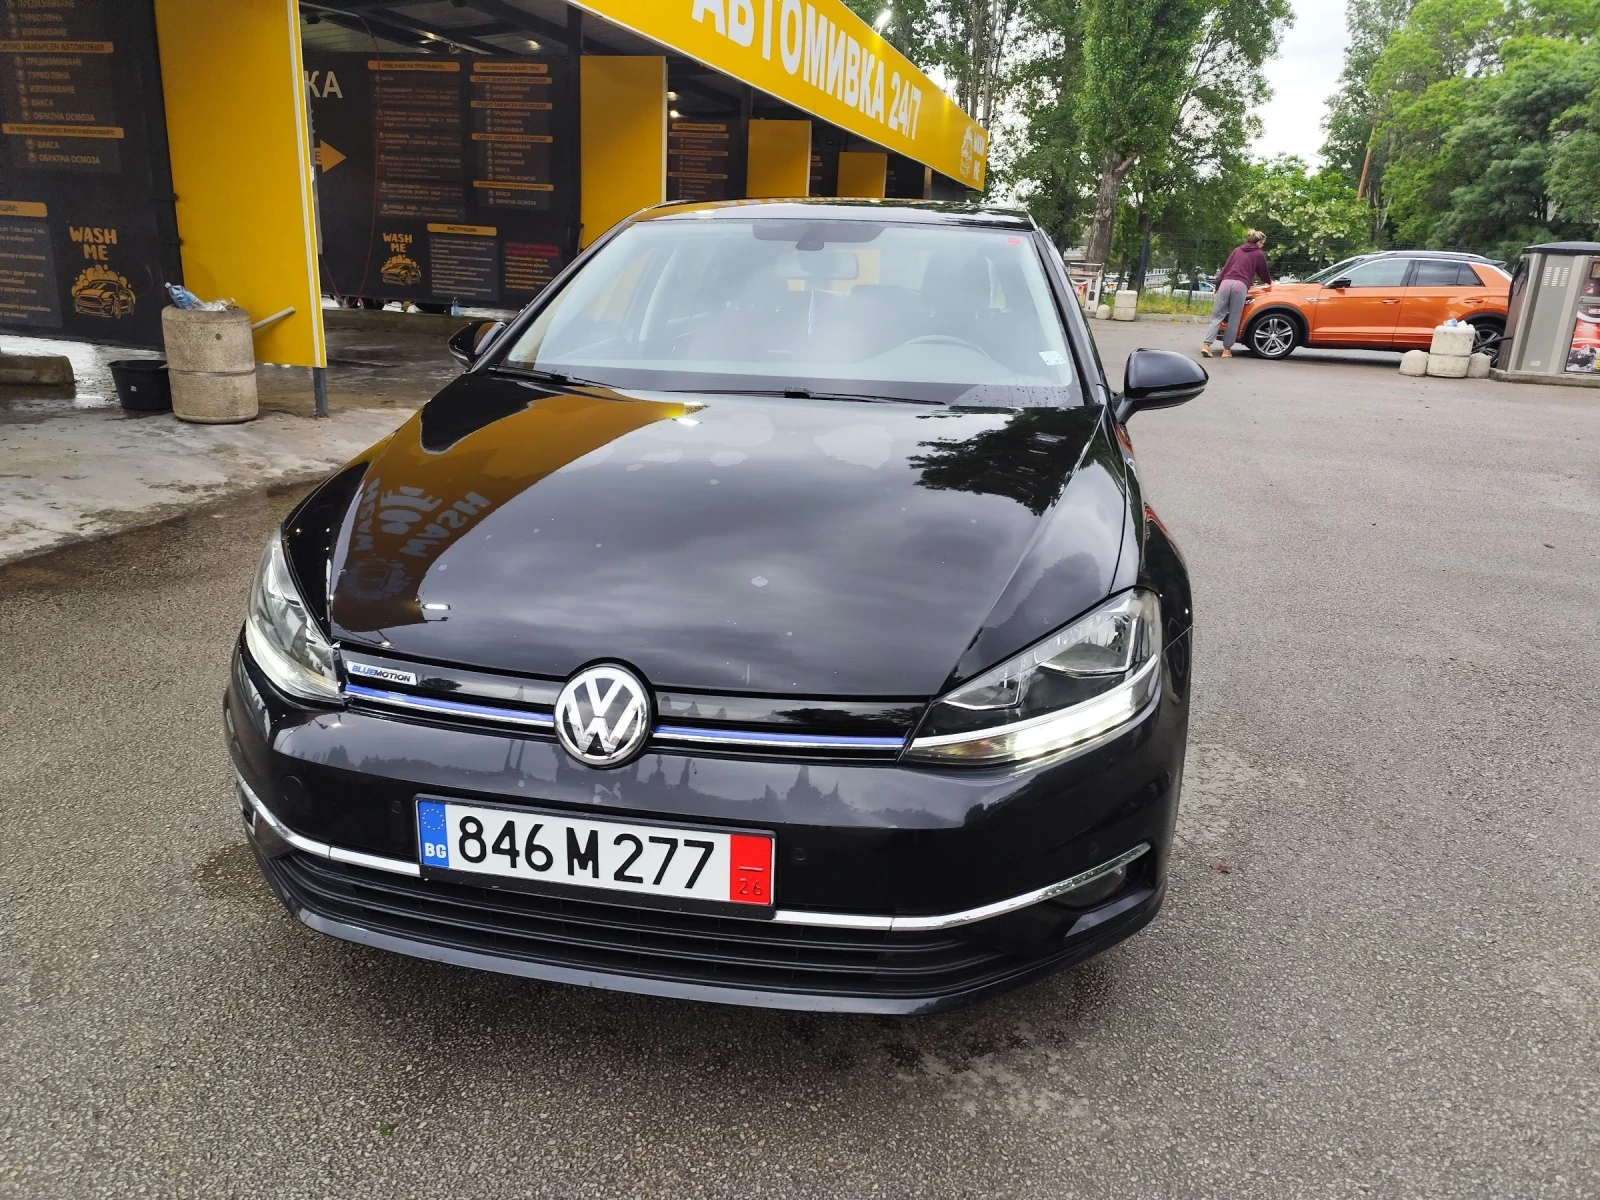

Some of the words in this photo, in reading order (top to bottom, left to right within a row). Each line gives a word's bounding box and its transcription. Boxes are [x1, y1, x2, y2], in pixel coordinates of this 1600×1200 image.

[888, 71, 923, 141] 24/7
[69, 226, 118, 244] WASH
[383, 233, 413, 243] WASH
[83, 243, 108, 261] ME
[391, 243, 406, 252] ME
[352, 665, 411, 682] BLUEMOTION
[424, 842, 447, 859] BG
[458, 815, 554, 872] 846
[566, 826, 600, 879] M
[613, 833, 715, 889] 277
[738, 877, 763, 897] 26
